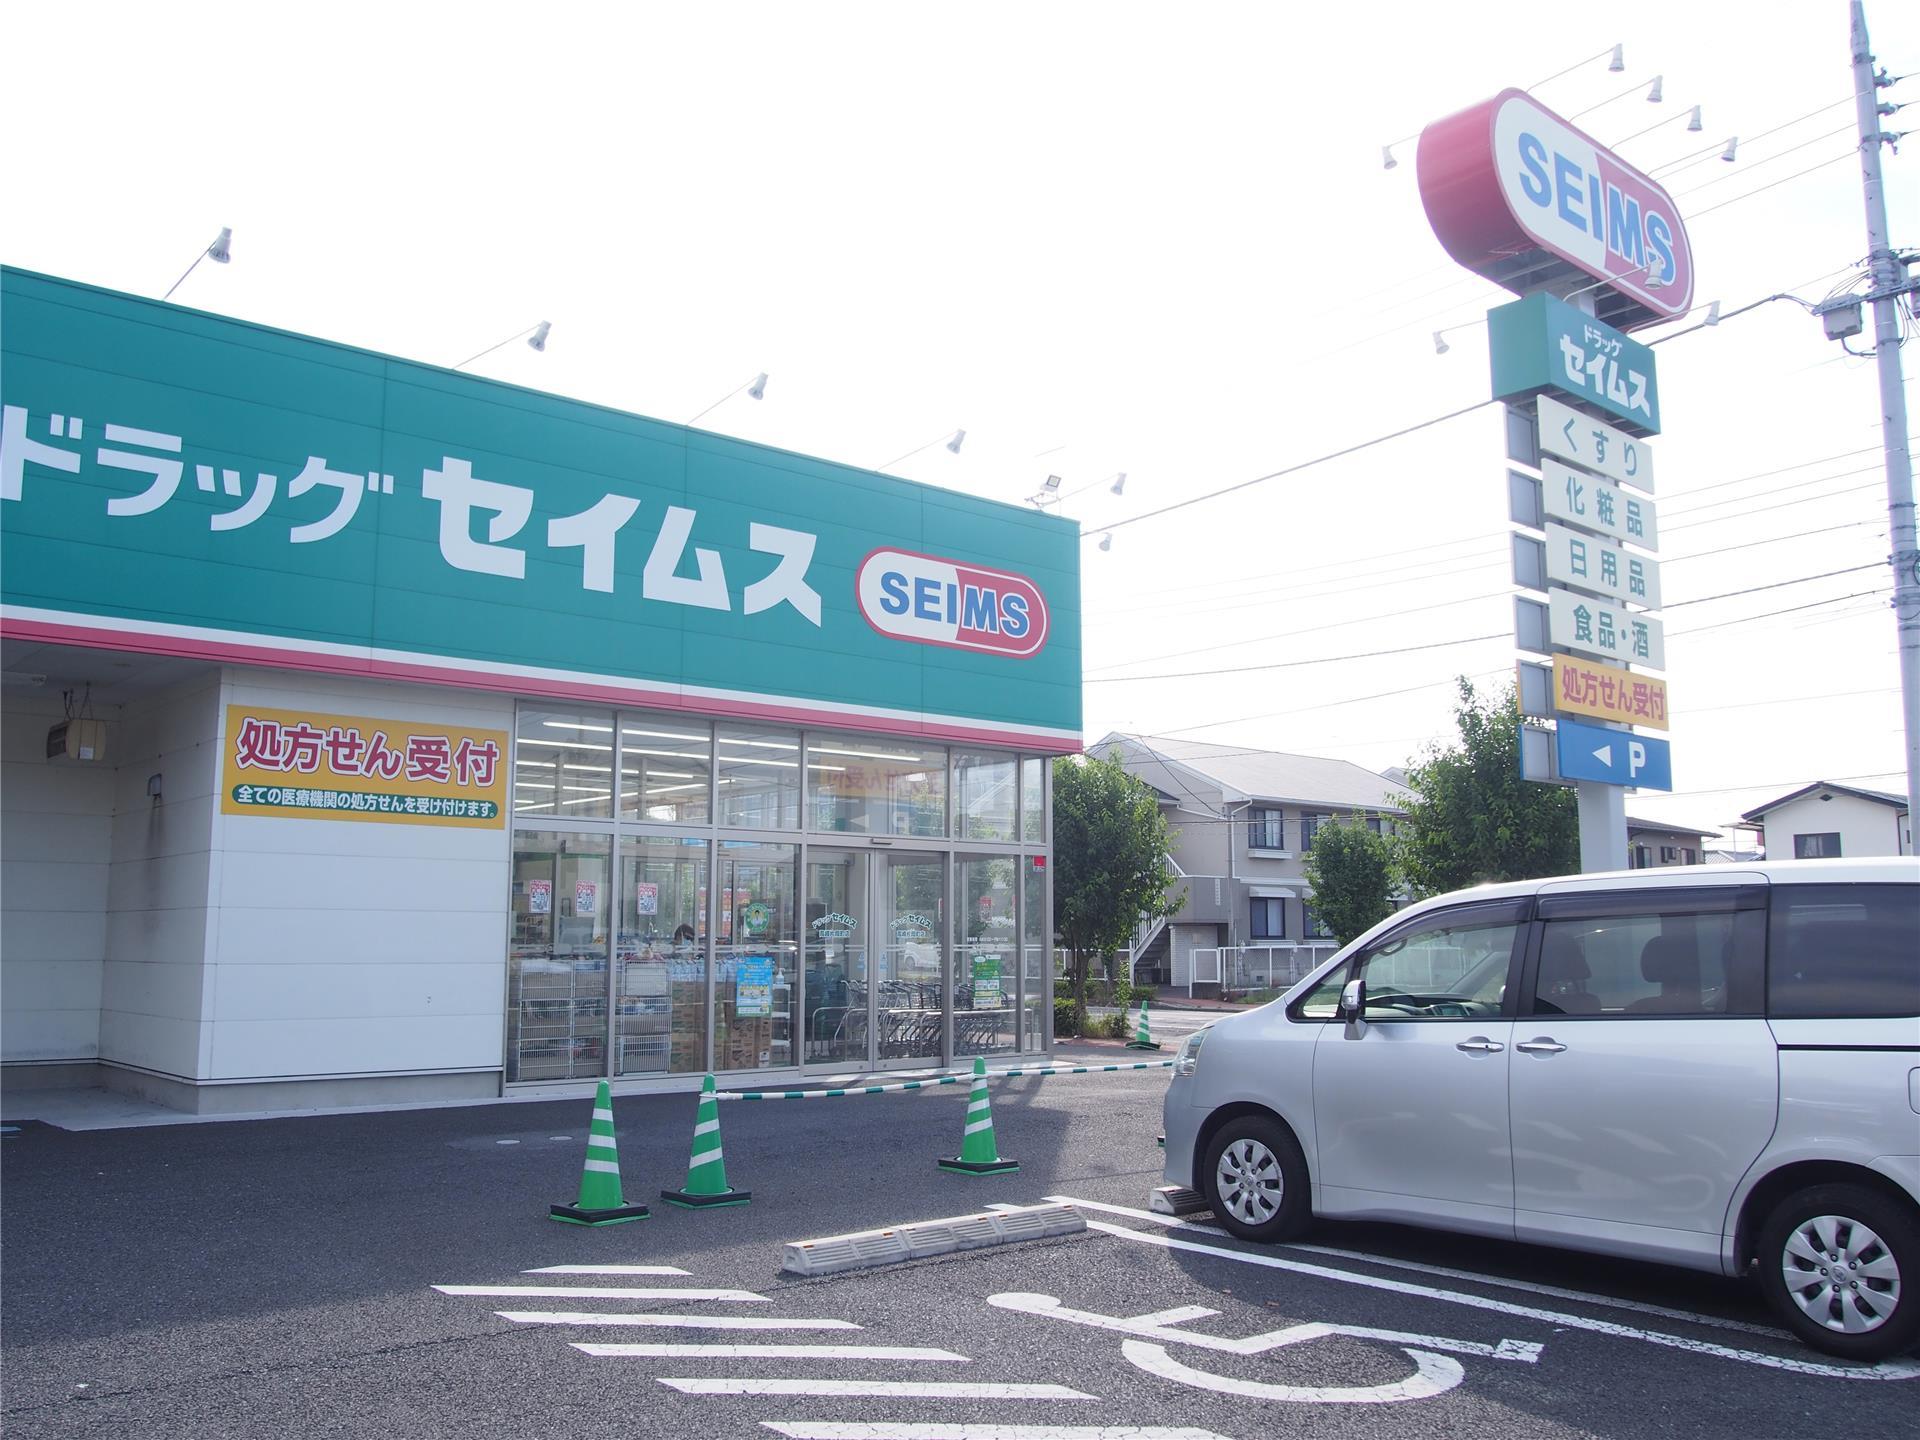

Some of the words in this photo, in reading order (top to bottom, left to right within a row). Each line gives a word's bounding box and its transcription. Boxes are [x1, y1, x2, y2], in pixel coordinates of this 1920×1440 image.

[1517, 131, 1676, 285] SEIMS
[1583, 323, 1624, 357] ドラッグ
[1559, 333, 1651, 419] セイムス
[1562, 417, 1638, 477] くすり
[1565, 475, 1643, 538] 化粧品
[1569, 538, 1646, 598] 日用品
[878, 570, 1032, 640] SEIMS
[1572, 603, 1650, 661] 食品・酒
[1561, 663, 1665, 721] 処方せん受付
[235, 716, 500, 788] 処方せん受付
[1628, 741, 1646, 779] P
[238, 784, 496, 818] 全ての医療機関の処方せんを受け付けます。
